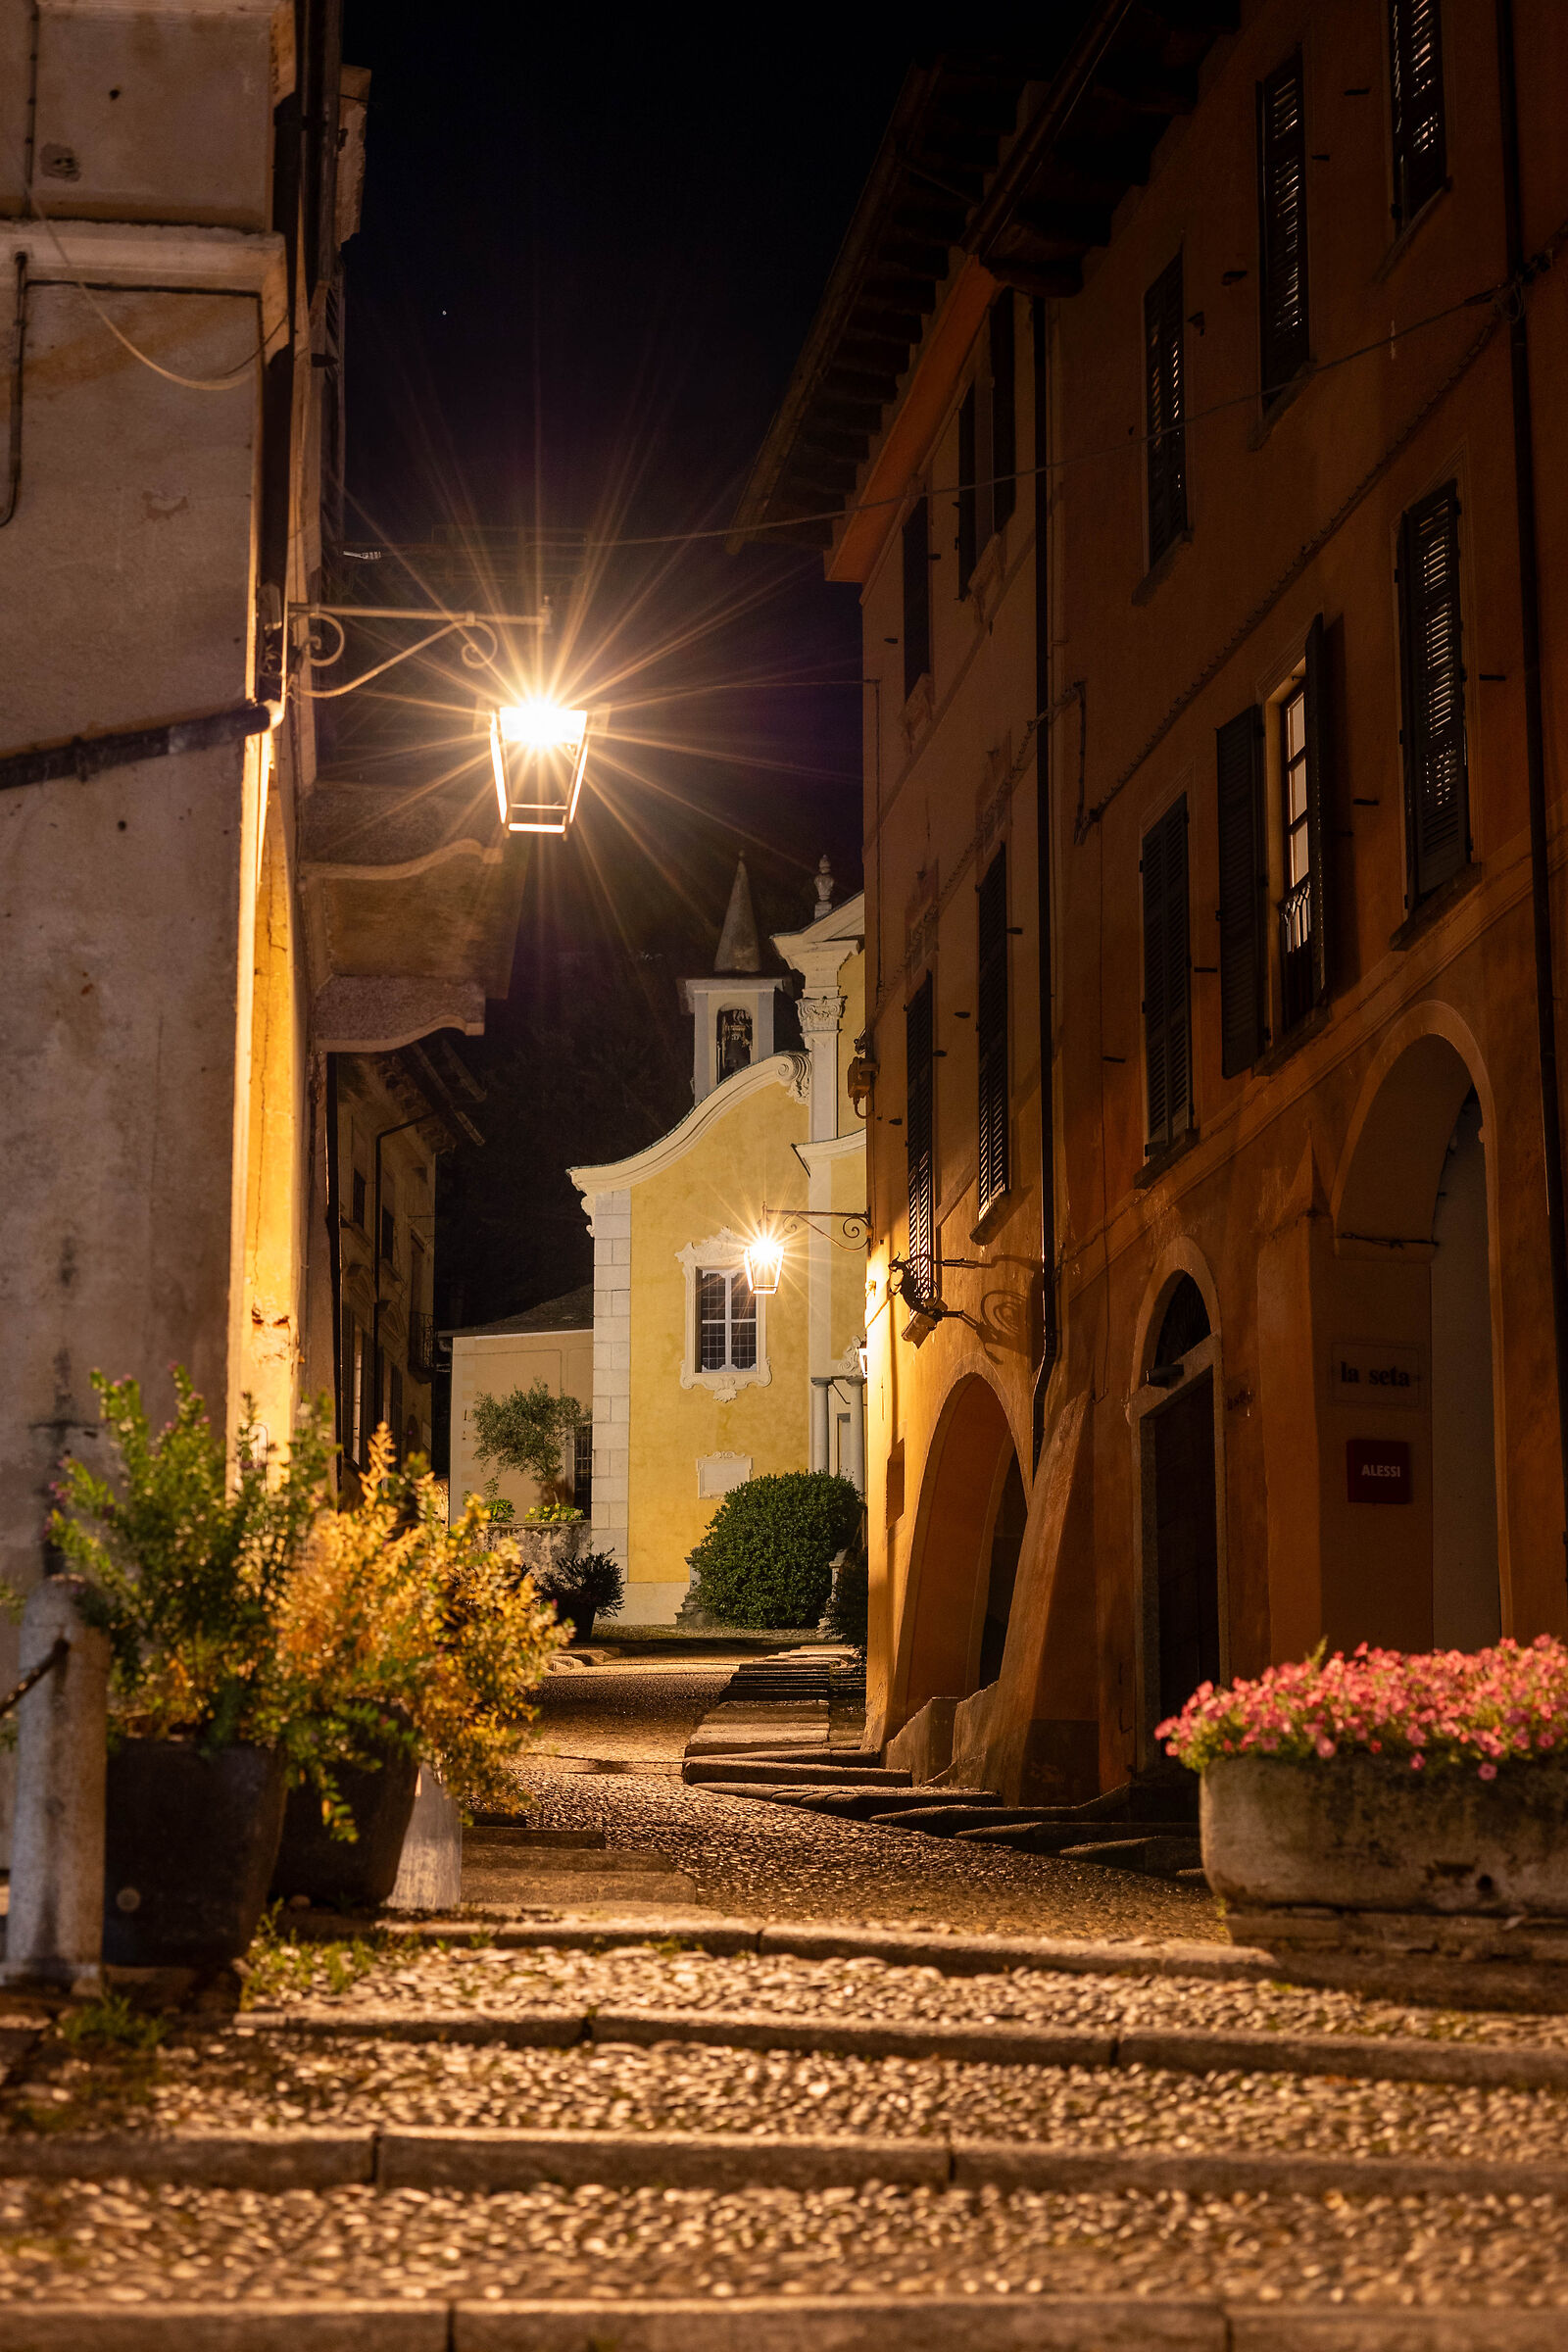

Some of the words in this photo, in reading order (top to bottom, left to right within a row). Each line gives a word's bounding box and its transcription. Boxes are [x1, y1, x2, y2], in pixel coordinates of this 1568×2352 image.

[1340, 1361, 1359, 1383] la
[1369, 1365, 1410, 1387] seta
[1361, 1464, 1401, 1478] ALESSI
